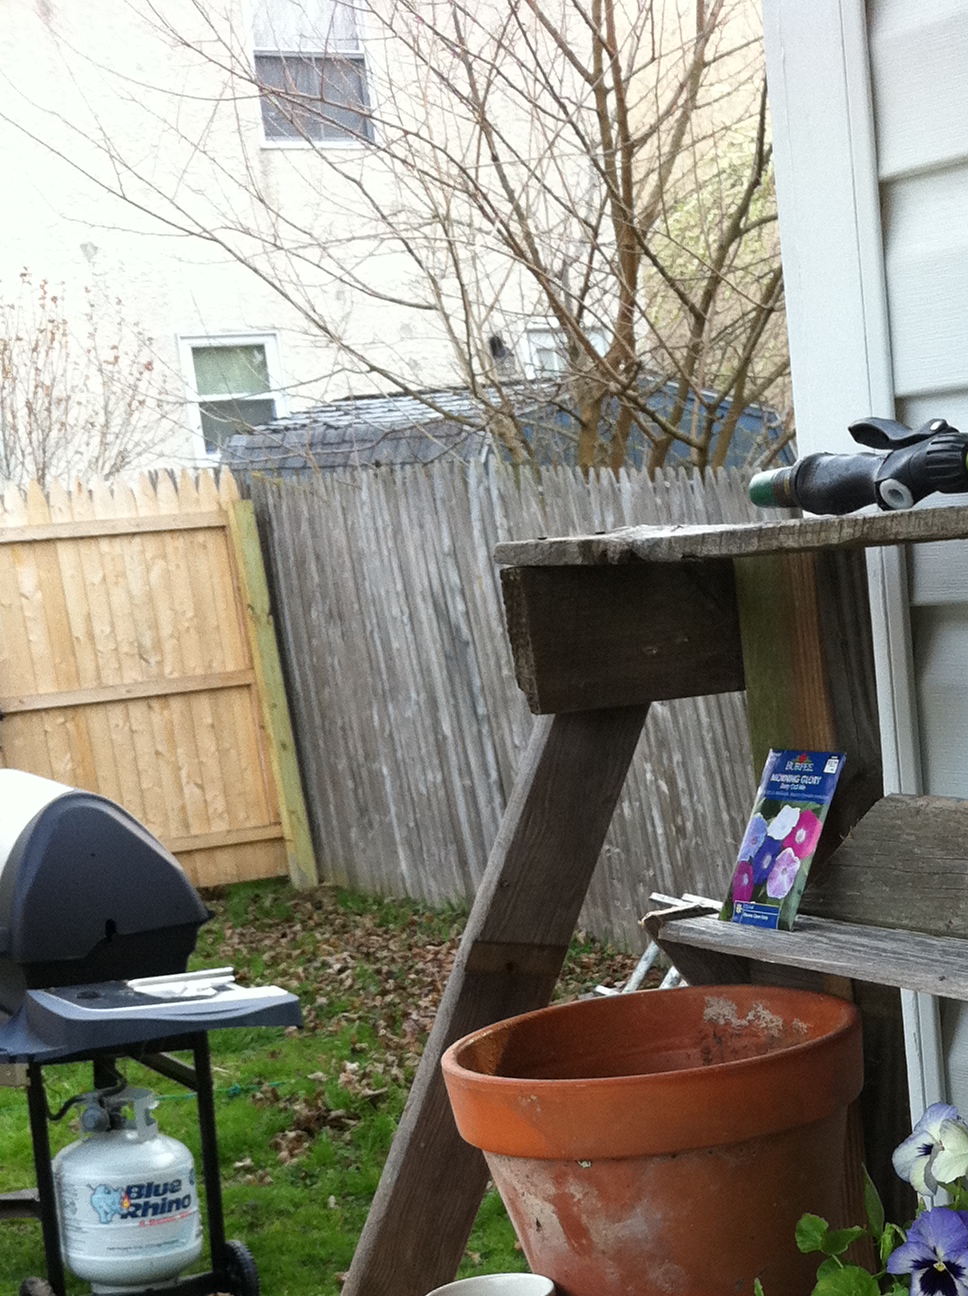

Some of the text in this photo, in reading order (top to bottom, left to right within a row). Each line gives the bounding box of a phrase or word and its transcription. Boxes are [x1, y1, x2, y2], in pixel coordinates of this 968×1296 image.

[770, 773, 822, 785] MORNING GLORY
[126, 1178, 182, 1200] Blue
[120, 1194, 191, 1219] Rhino
